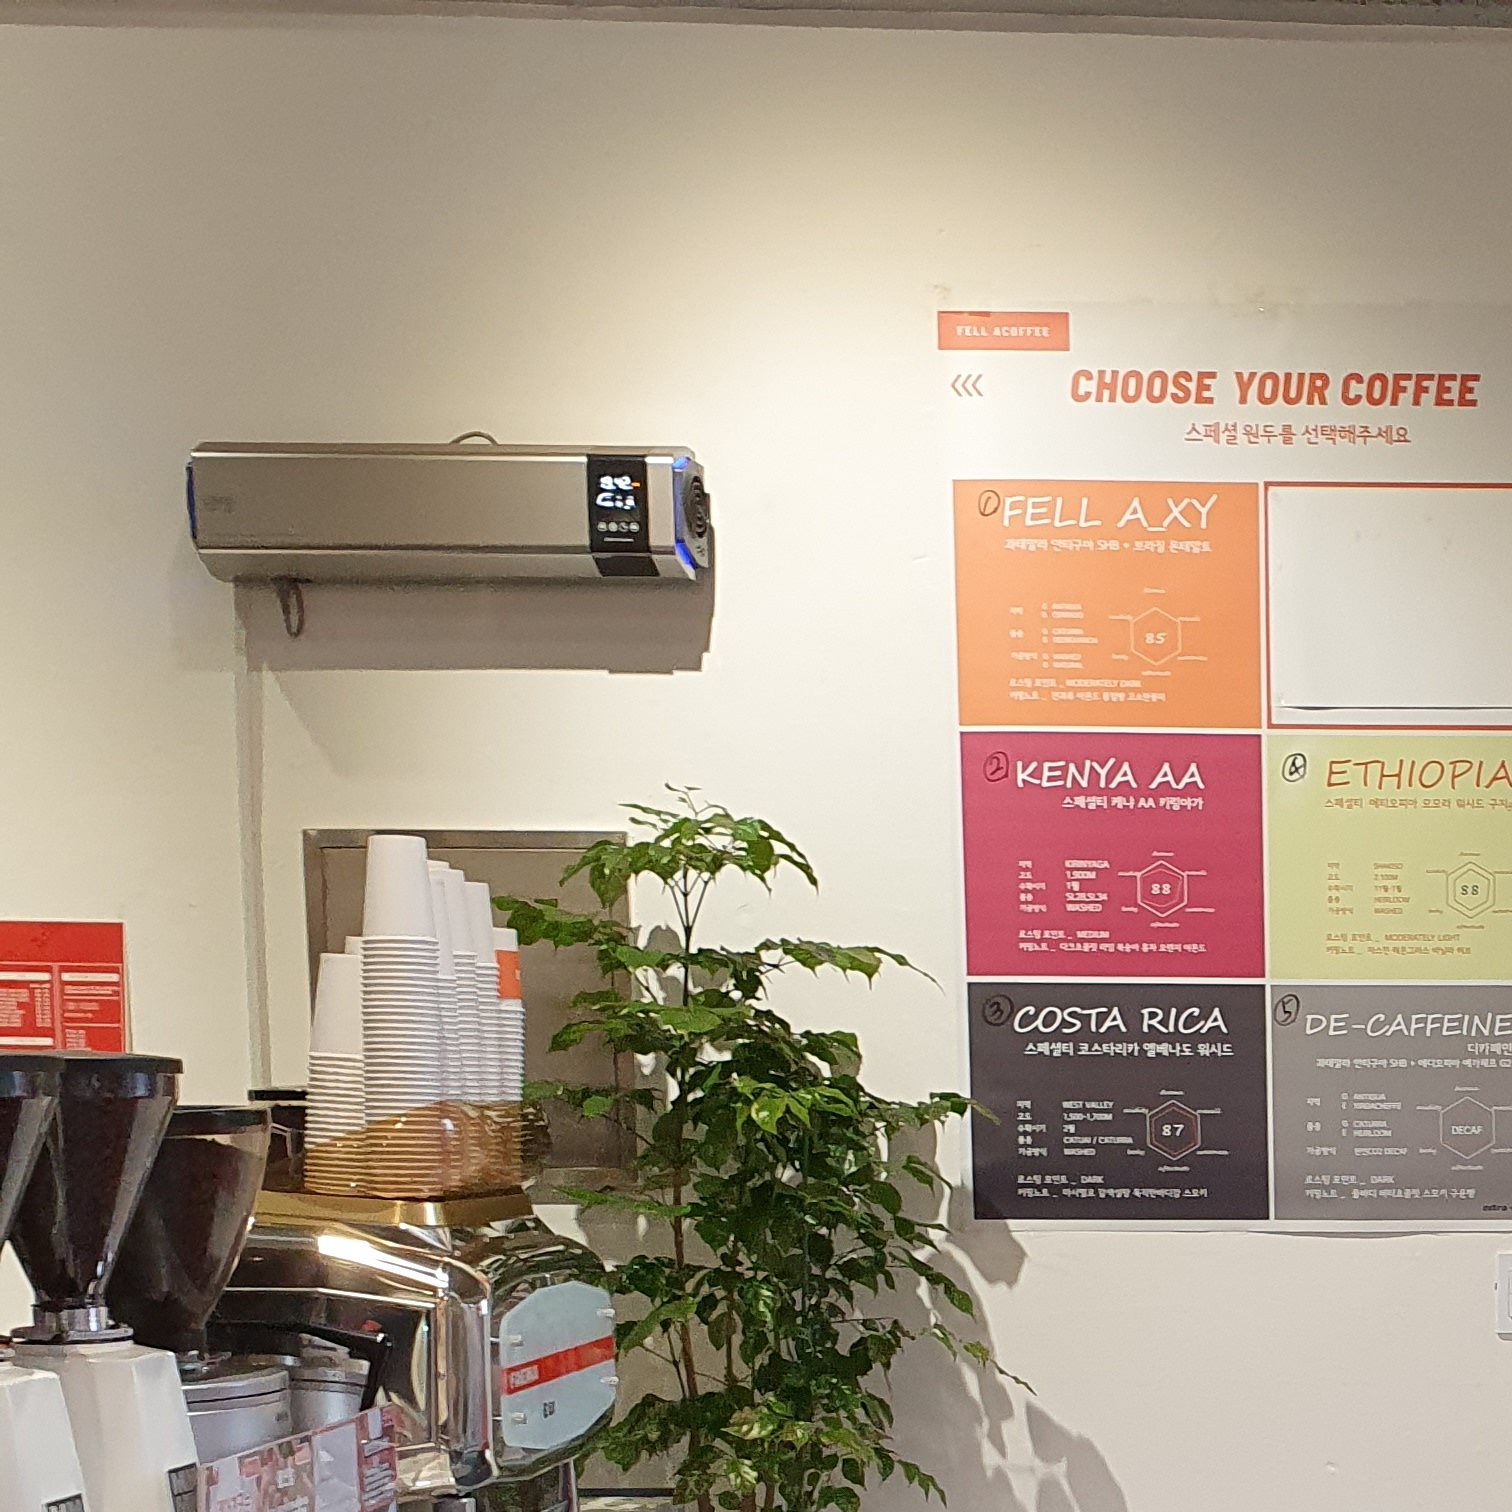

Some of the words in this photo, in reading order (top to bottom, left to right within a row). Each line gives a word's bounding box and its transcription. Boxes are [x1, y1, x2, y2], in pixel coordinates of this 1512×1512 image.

[957, 325, 988, 337] FELL
[993, 325, 1050, 338] ACOFFEE
[1071, 369, 1218, 404] CHOOSE
[1235, 370, 1329, 406] YOUR
[1341, 372, 1481, 407] COFFEE
[1184, 423, 1239, 445] 스페셜
[1242, 424, 1297, 446] 원두를
[1301, 424, 1412, 447] 선택해주세요
[1003, 495, 1102, 528] FELL
[1117, 493, 1218, 532] A_XY
[1144, 633, 1167, 645] 85
[1016, 758, 1138, 789] KENYA
[1149, 762, 1206, 790] AA
[1138, 797, 1155, 808] AA
[1150, 883, 1171, 895] 88
[1013, 1006, 1128, 1033] COSTA
[1141, 1007, 1229, 1034] RICA
[1023, 1042, 1073, 1056] 스페셜티
[1077, 1043, 1140, 1056] 코스타리카
[1196, 1043, 1235, 1057] 워시드
[1467, 1042, 1512, 1056] 디카페인
[1161, 1123, 1185, 1136] 87
[1451, 1125, 1483, 1135] DECAF
